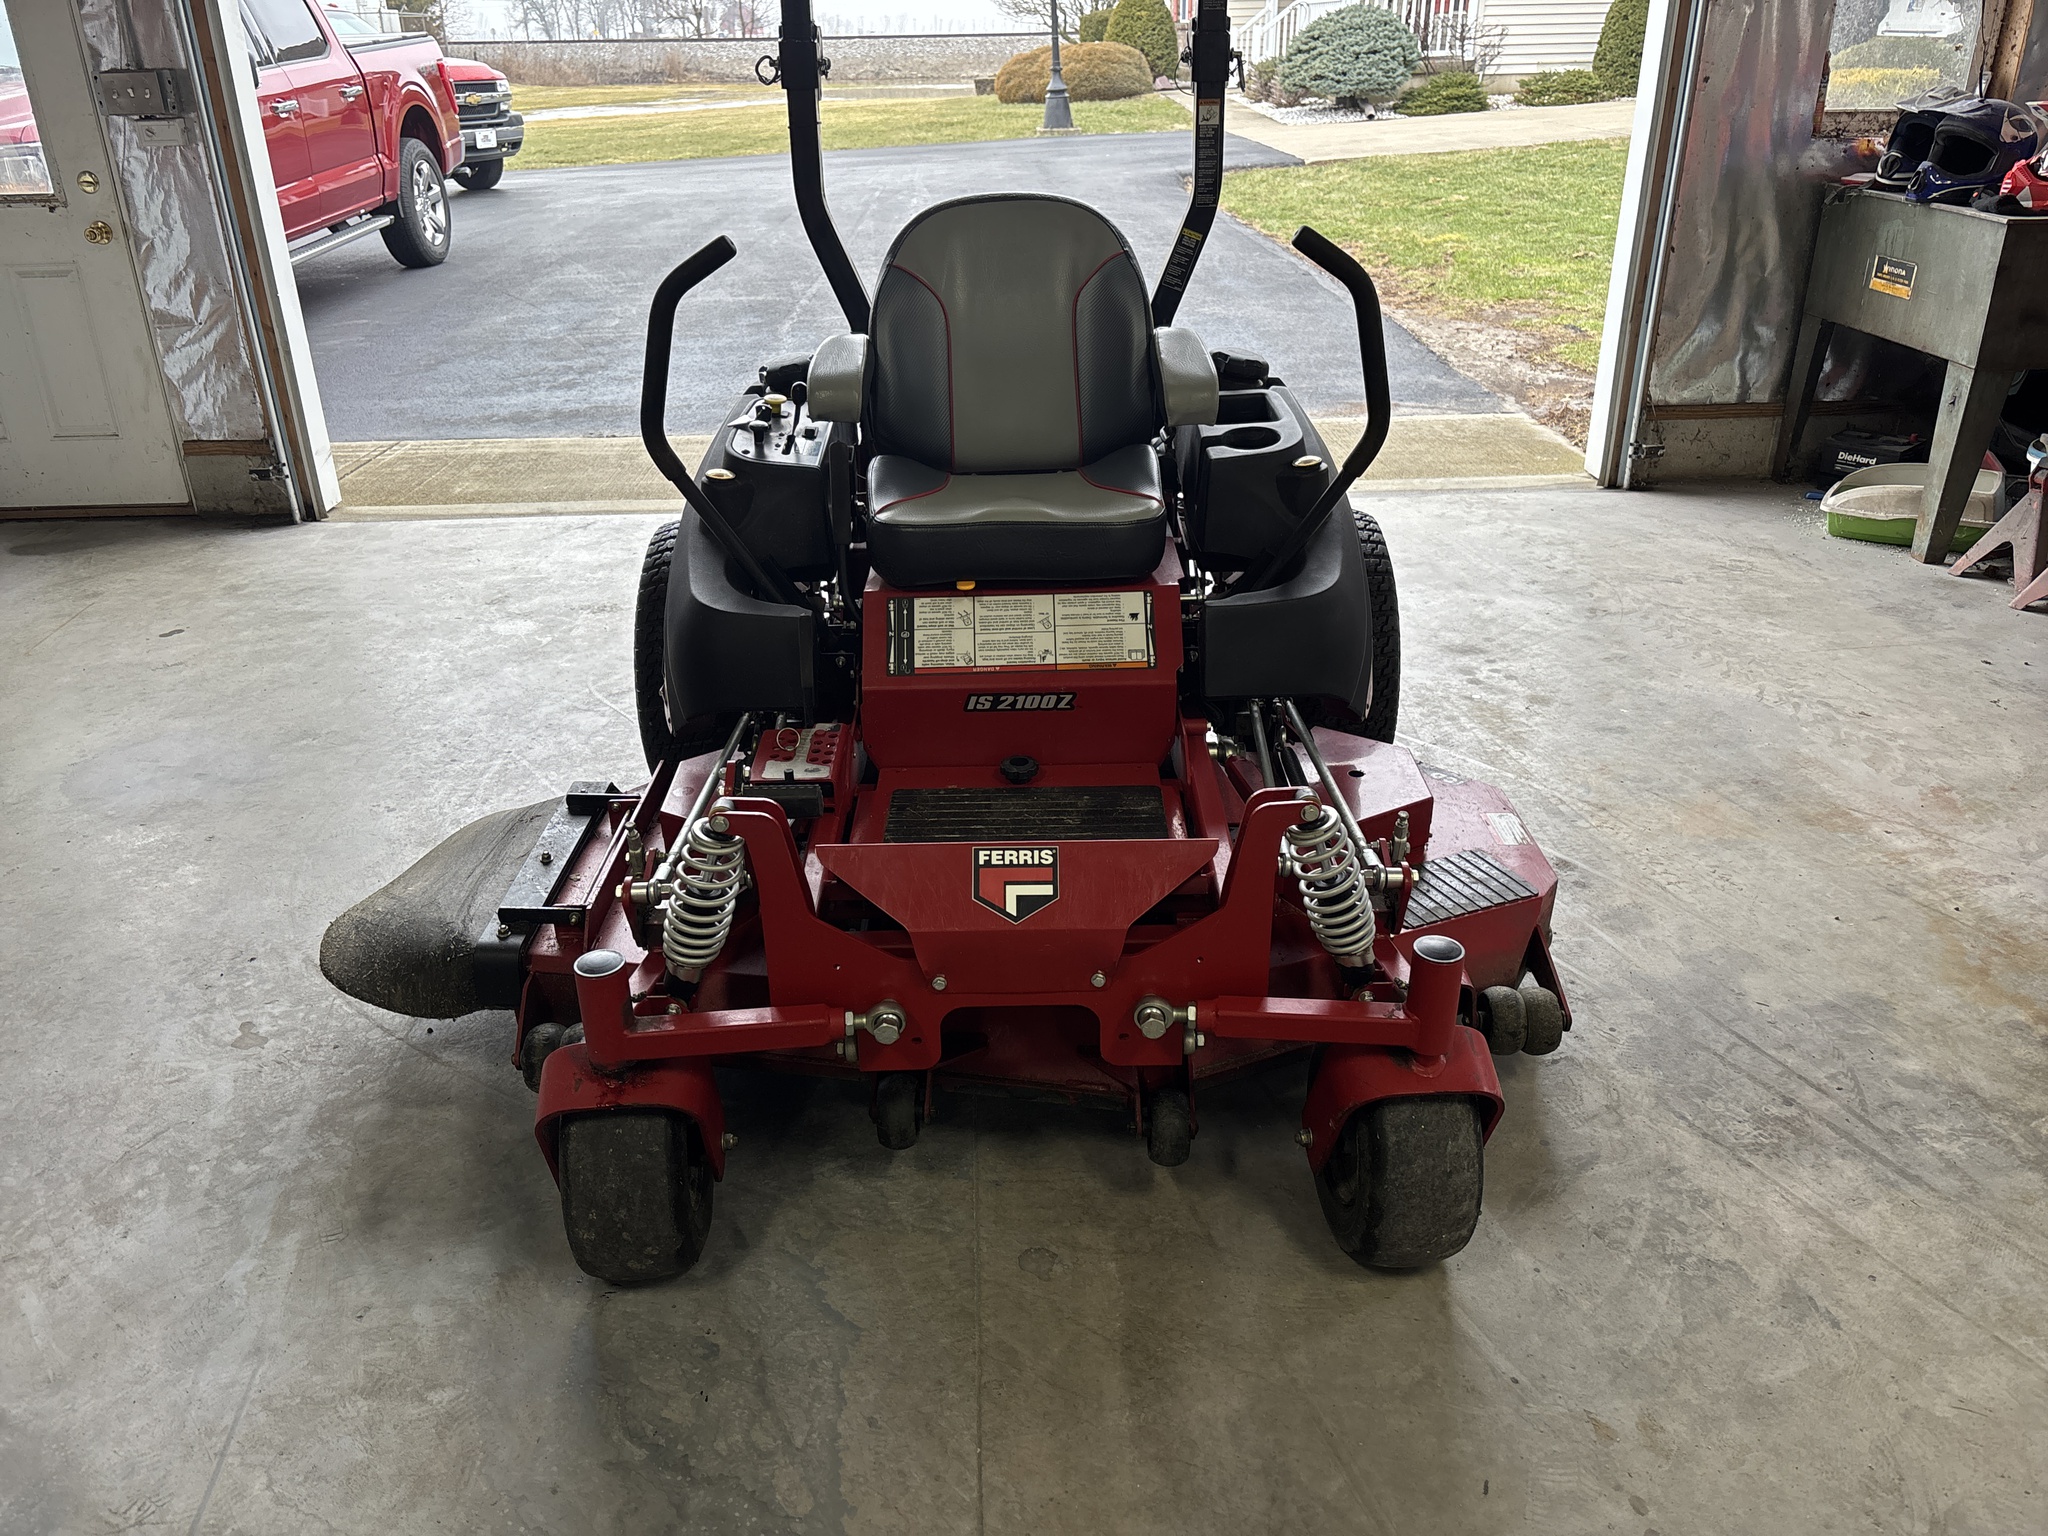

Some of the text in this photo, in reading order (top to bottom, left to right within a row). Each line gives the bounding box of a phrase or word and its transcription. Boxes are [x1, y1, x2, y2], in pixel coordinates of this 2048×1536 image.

[1838, 451, 1877, 465] DieHard
[967, 694, 1073, 709] IS 2100Z
[978, 849, 1054, 865] FERRIS
